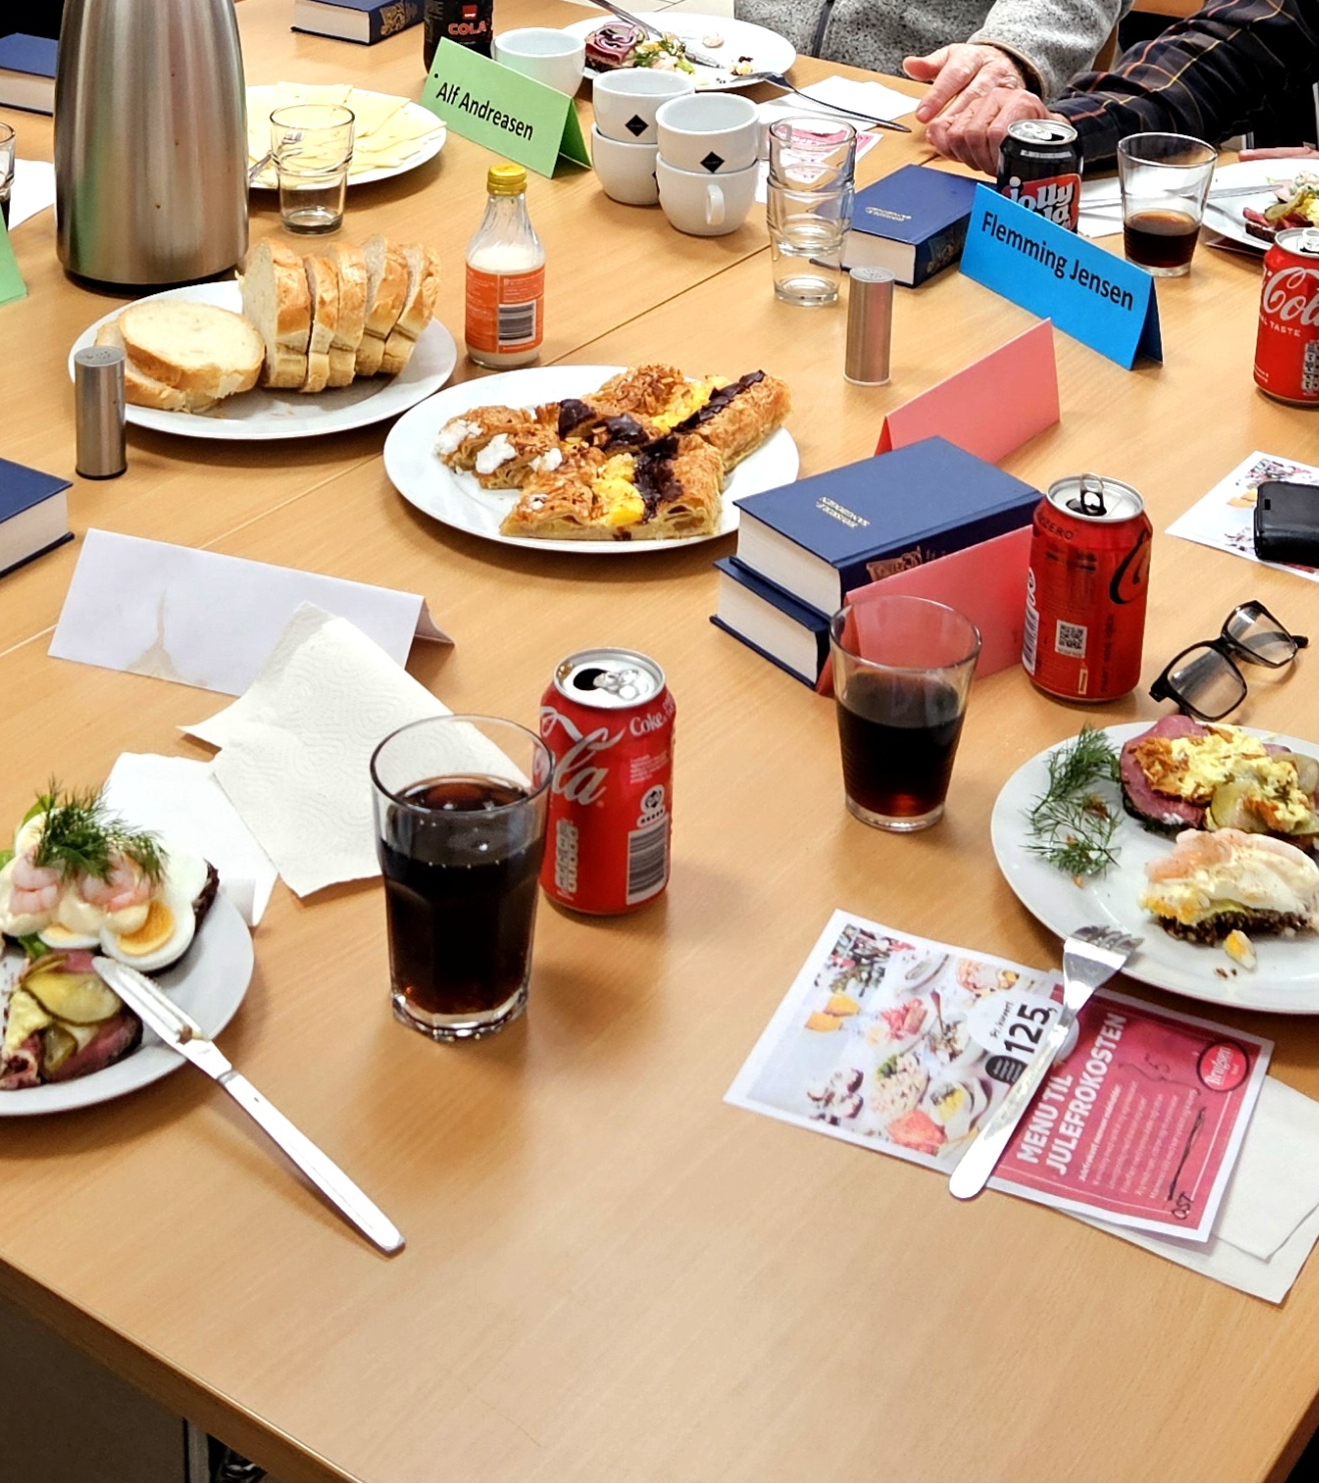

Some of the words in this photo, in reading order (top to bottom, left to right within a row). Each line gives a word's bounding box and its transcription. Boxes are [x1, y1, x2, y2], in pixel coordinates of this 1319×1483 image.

[448, 20, 487, 36] COLA
[435, 81, 461, 105] Alf
[458, 91, 534, 141] Andreasen
[981, 210, 1067, 279] Flemming
[1069, 259, 1134, 312] Jensen
[1270, 320, 1302, 338] TASTE
[629, 712, 664, 737] Coke
[1016, 1101, 1059, 1164] MENU
[1042, 1073, 1074, 1102] TIL
[1045, 1011, 1128, 1176] JULEFROKOSTEN
